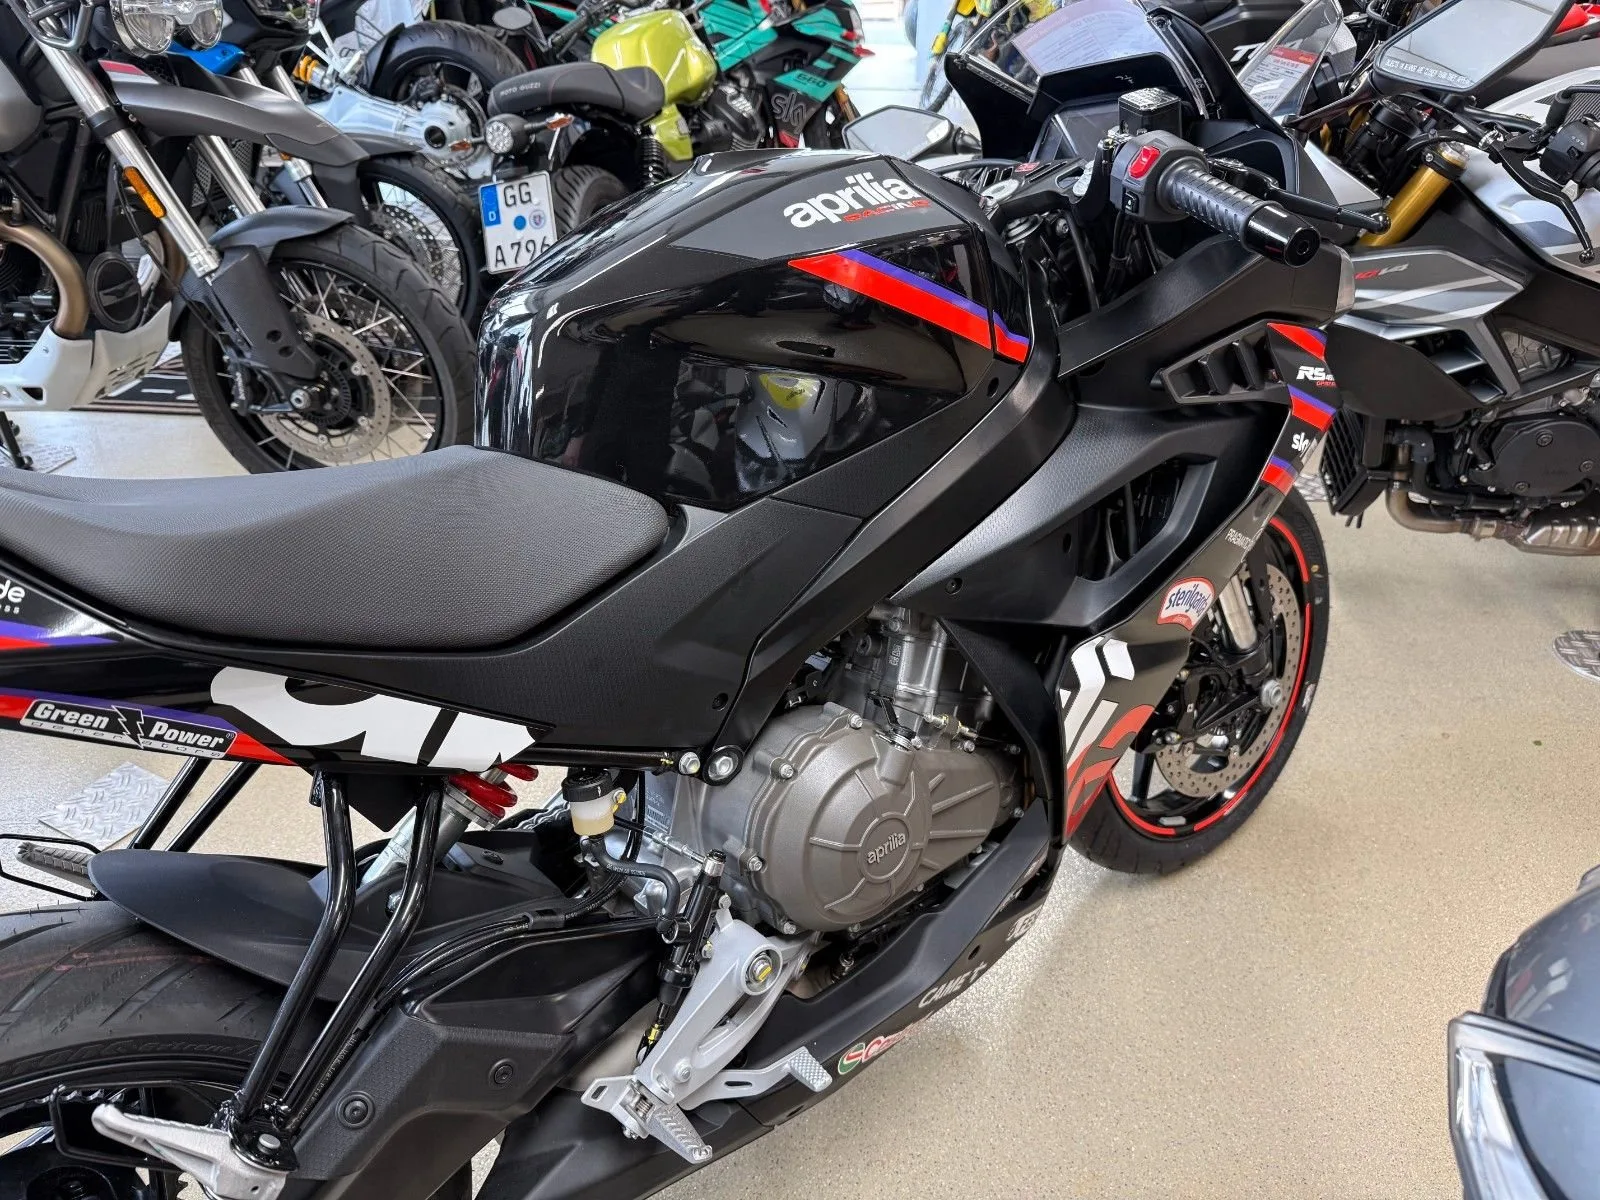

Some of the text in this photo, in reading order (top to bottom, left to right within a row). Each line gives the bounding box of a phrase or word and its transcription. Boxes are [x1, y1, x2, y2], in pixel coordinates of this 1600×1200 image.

[503, 182, 532, 208] GG
[783, 171, 922, 229] aprilia
[488, 211, 497, 222] D
[1296, 365, 1326, 381] RS
[33, 703, 225, 748] Green Power
[867, 832, 906, 864] aprilia
